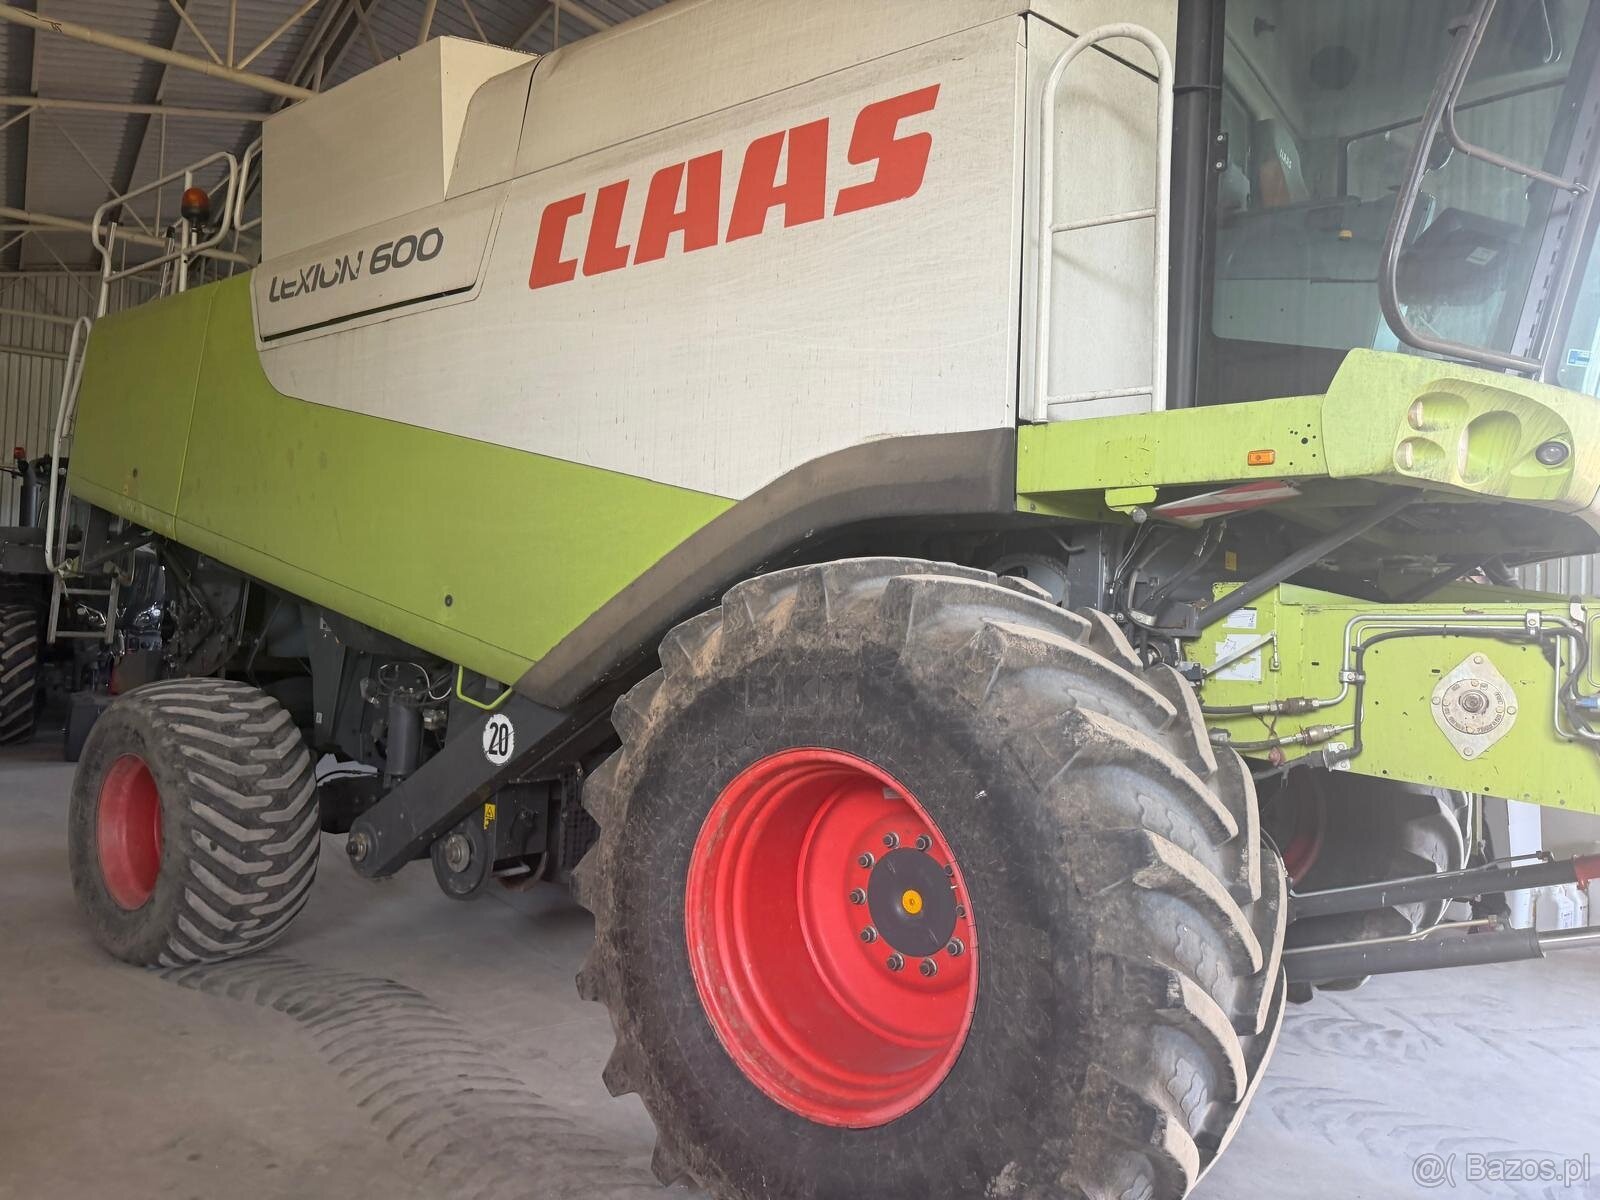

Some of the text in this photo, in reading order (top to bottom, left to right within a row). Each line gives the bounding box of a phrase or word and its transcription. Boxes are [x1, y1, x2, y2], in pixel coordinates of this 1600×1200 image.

[529, 83, 941, 290] CLAAS
[269, 227, 444, 302] LEXION 600
[489, 721, 509, 757] 20
